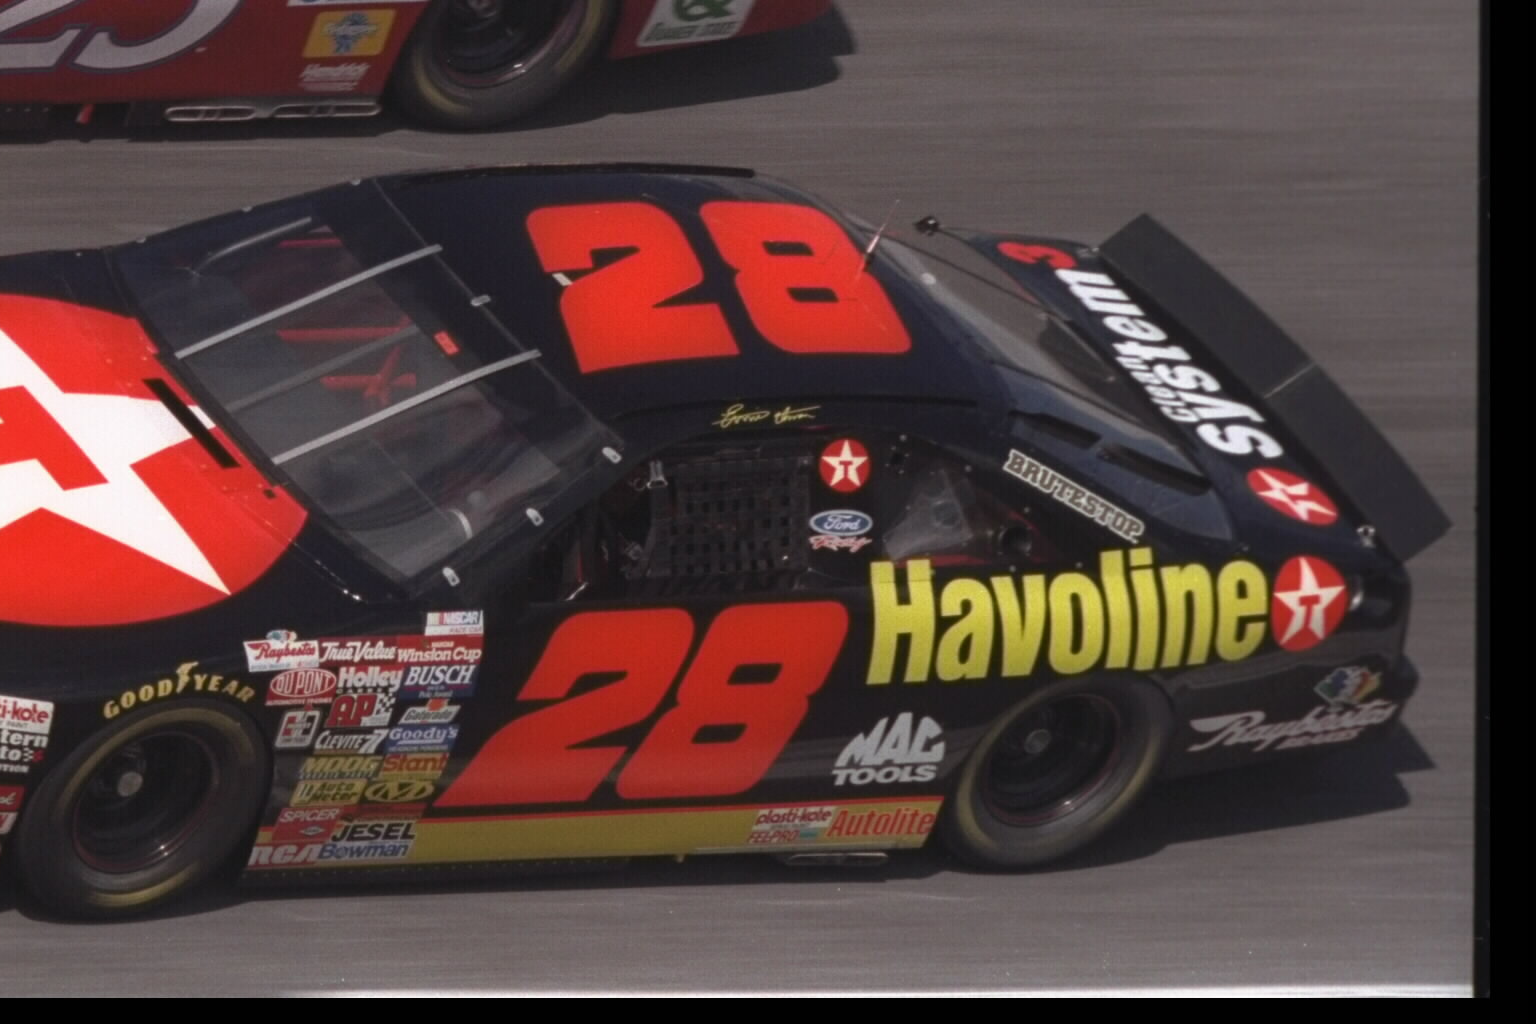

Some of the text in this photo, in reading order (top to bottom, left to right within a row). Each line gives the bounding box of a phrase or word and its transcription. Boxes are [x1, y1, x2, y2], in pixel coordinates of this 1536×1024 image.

[526, 201, 914, 374] 28
[1005, 451, 1144, 541] BRUTESTOP
[823, 515, 861, 530] Ford
[865, 546, 1269, 686] Havoline
[320, 639, 398, 663] True Value
[397, 646, 482, 663] Winston Cup
[338, 665, 404, 693] Holley
[404, 664, 476, 686] BUSCH
[325, 693, 378, 726] AP
[430, 600, 850, 808] 28
[389, 726, 458, 742] Goody's
[834, 712, 946, 767] MAC
[302, 756, 383, 773] MOOG
[383, 753, 449, 773] Stant
[831, 764, 938, 786] TOOLS
[280, 808, 341, 823] SPICER
[755, 807, 833, 826] plasti-kote
[826, 808, 936, 837] Autolite
[332, 822, 416, 842] JESEL
[248, 843, 323, 866] RCA
[318, 843, 409, 860] Bowman
